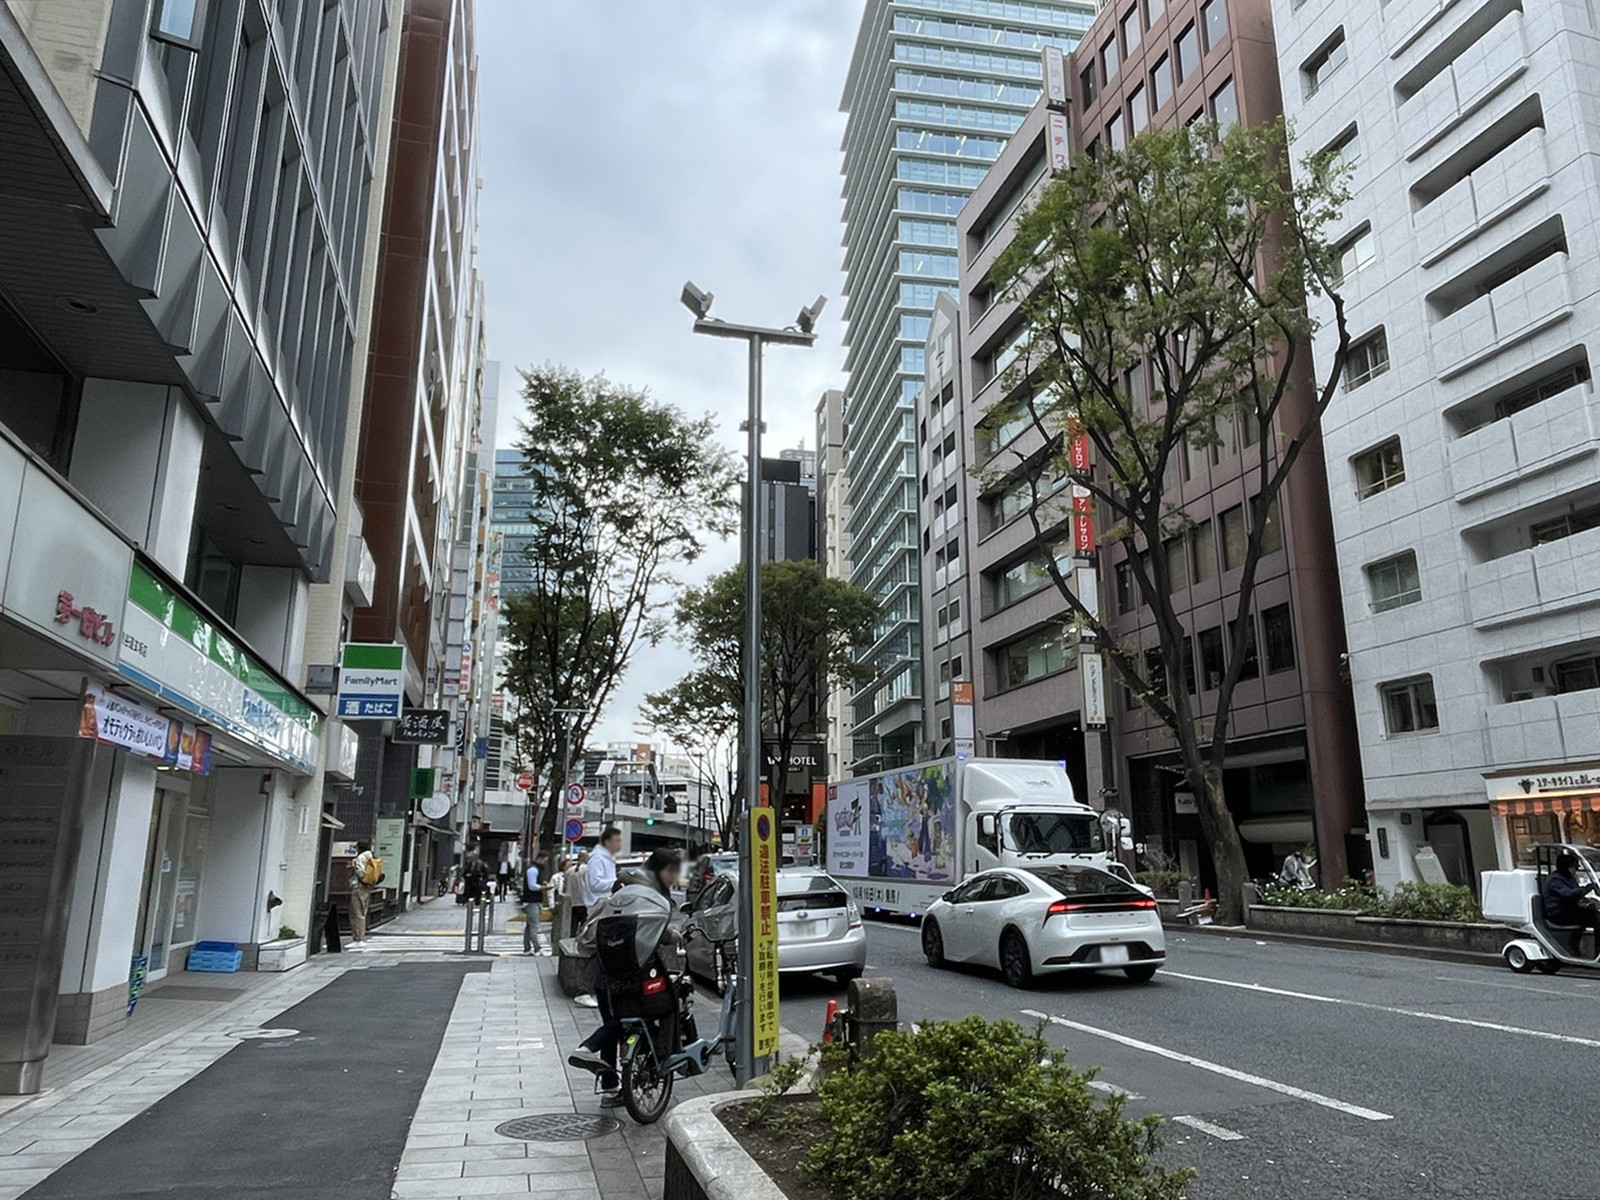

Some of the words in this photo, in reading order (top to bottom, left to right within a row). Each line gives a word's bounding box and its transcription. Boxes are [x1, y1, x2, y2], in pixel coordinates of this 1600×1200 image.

[344, 676, 398, 687] FamilyMart
[345, 701, 360, 715] 酒
[364, 703, 393, 714] たばこ
[789, 756, 817, 766] HOTEL
[759, 844, 771, 937] 違法駐車禁止
